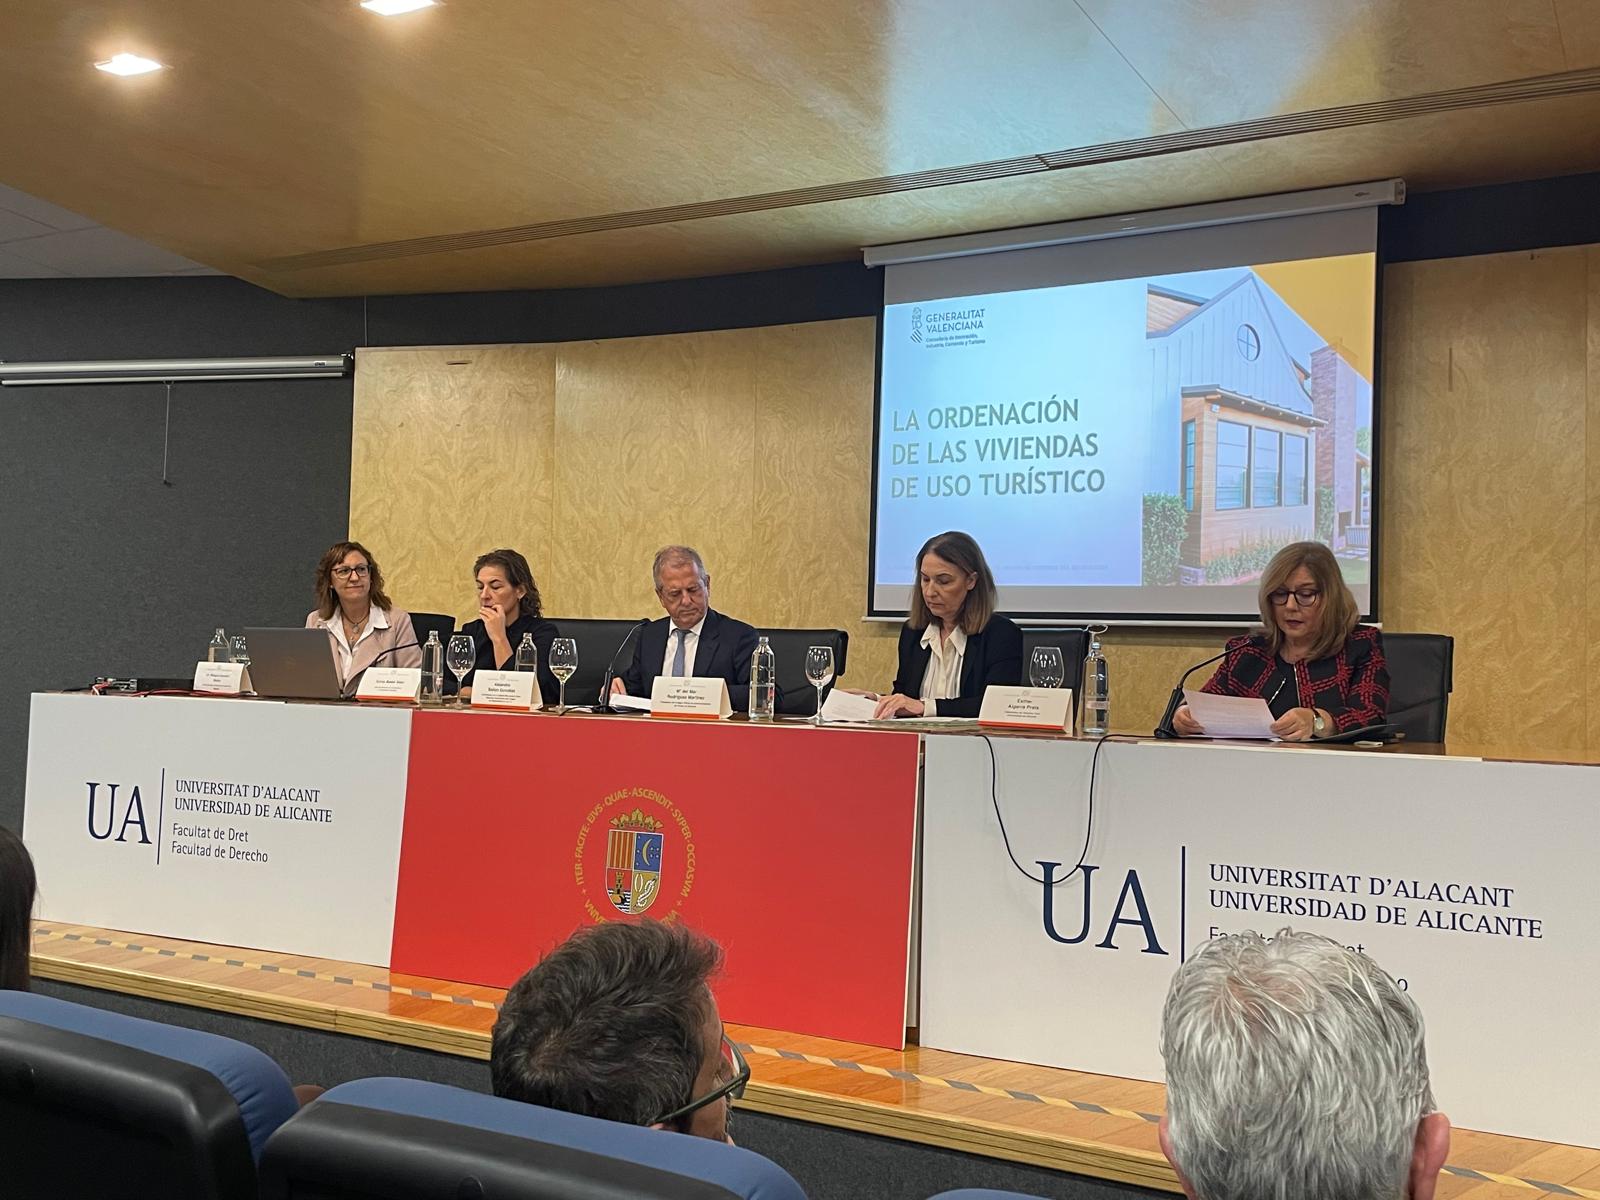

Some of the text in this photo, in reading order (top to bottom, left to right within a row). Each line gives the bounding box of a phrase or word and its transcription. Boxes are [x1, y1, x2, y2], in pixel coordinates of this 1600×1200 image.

[926, 308, 985, 323] GENERALITAT
[926, 320, 984, 333] VALENCIANA
[893, 394, 1079, 432] LA ORDENACIÓN
[892, 433, 1099, 465] DE LAS VIVIENDAS
[891, 466, 1105, 498] DE USO TURÍSTICO
[175, 780, 250, 798] UNIVERSITAT
[631, 787, 673, 810] ASCENDIT
[86, 782, 152, 844] UA
[174, 798, 332, 823] UNIVERSIDAD DE ALICANTE
[671, 808, 692, 840] SVPER
[172, 823, 249, 843] Facultat de Dret
[171, 841, 268, 863] Facultad de Derecho
[680, 843, 696, 897] OCCASVM
[1209, 863, 1361, 894] UNIVERSITAT
[1035, 861, 1169, 955] UA
[1209, 889, 1543, 939] UNIVERSIDAD DE ALICANTE
